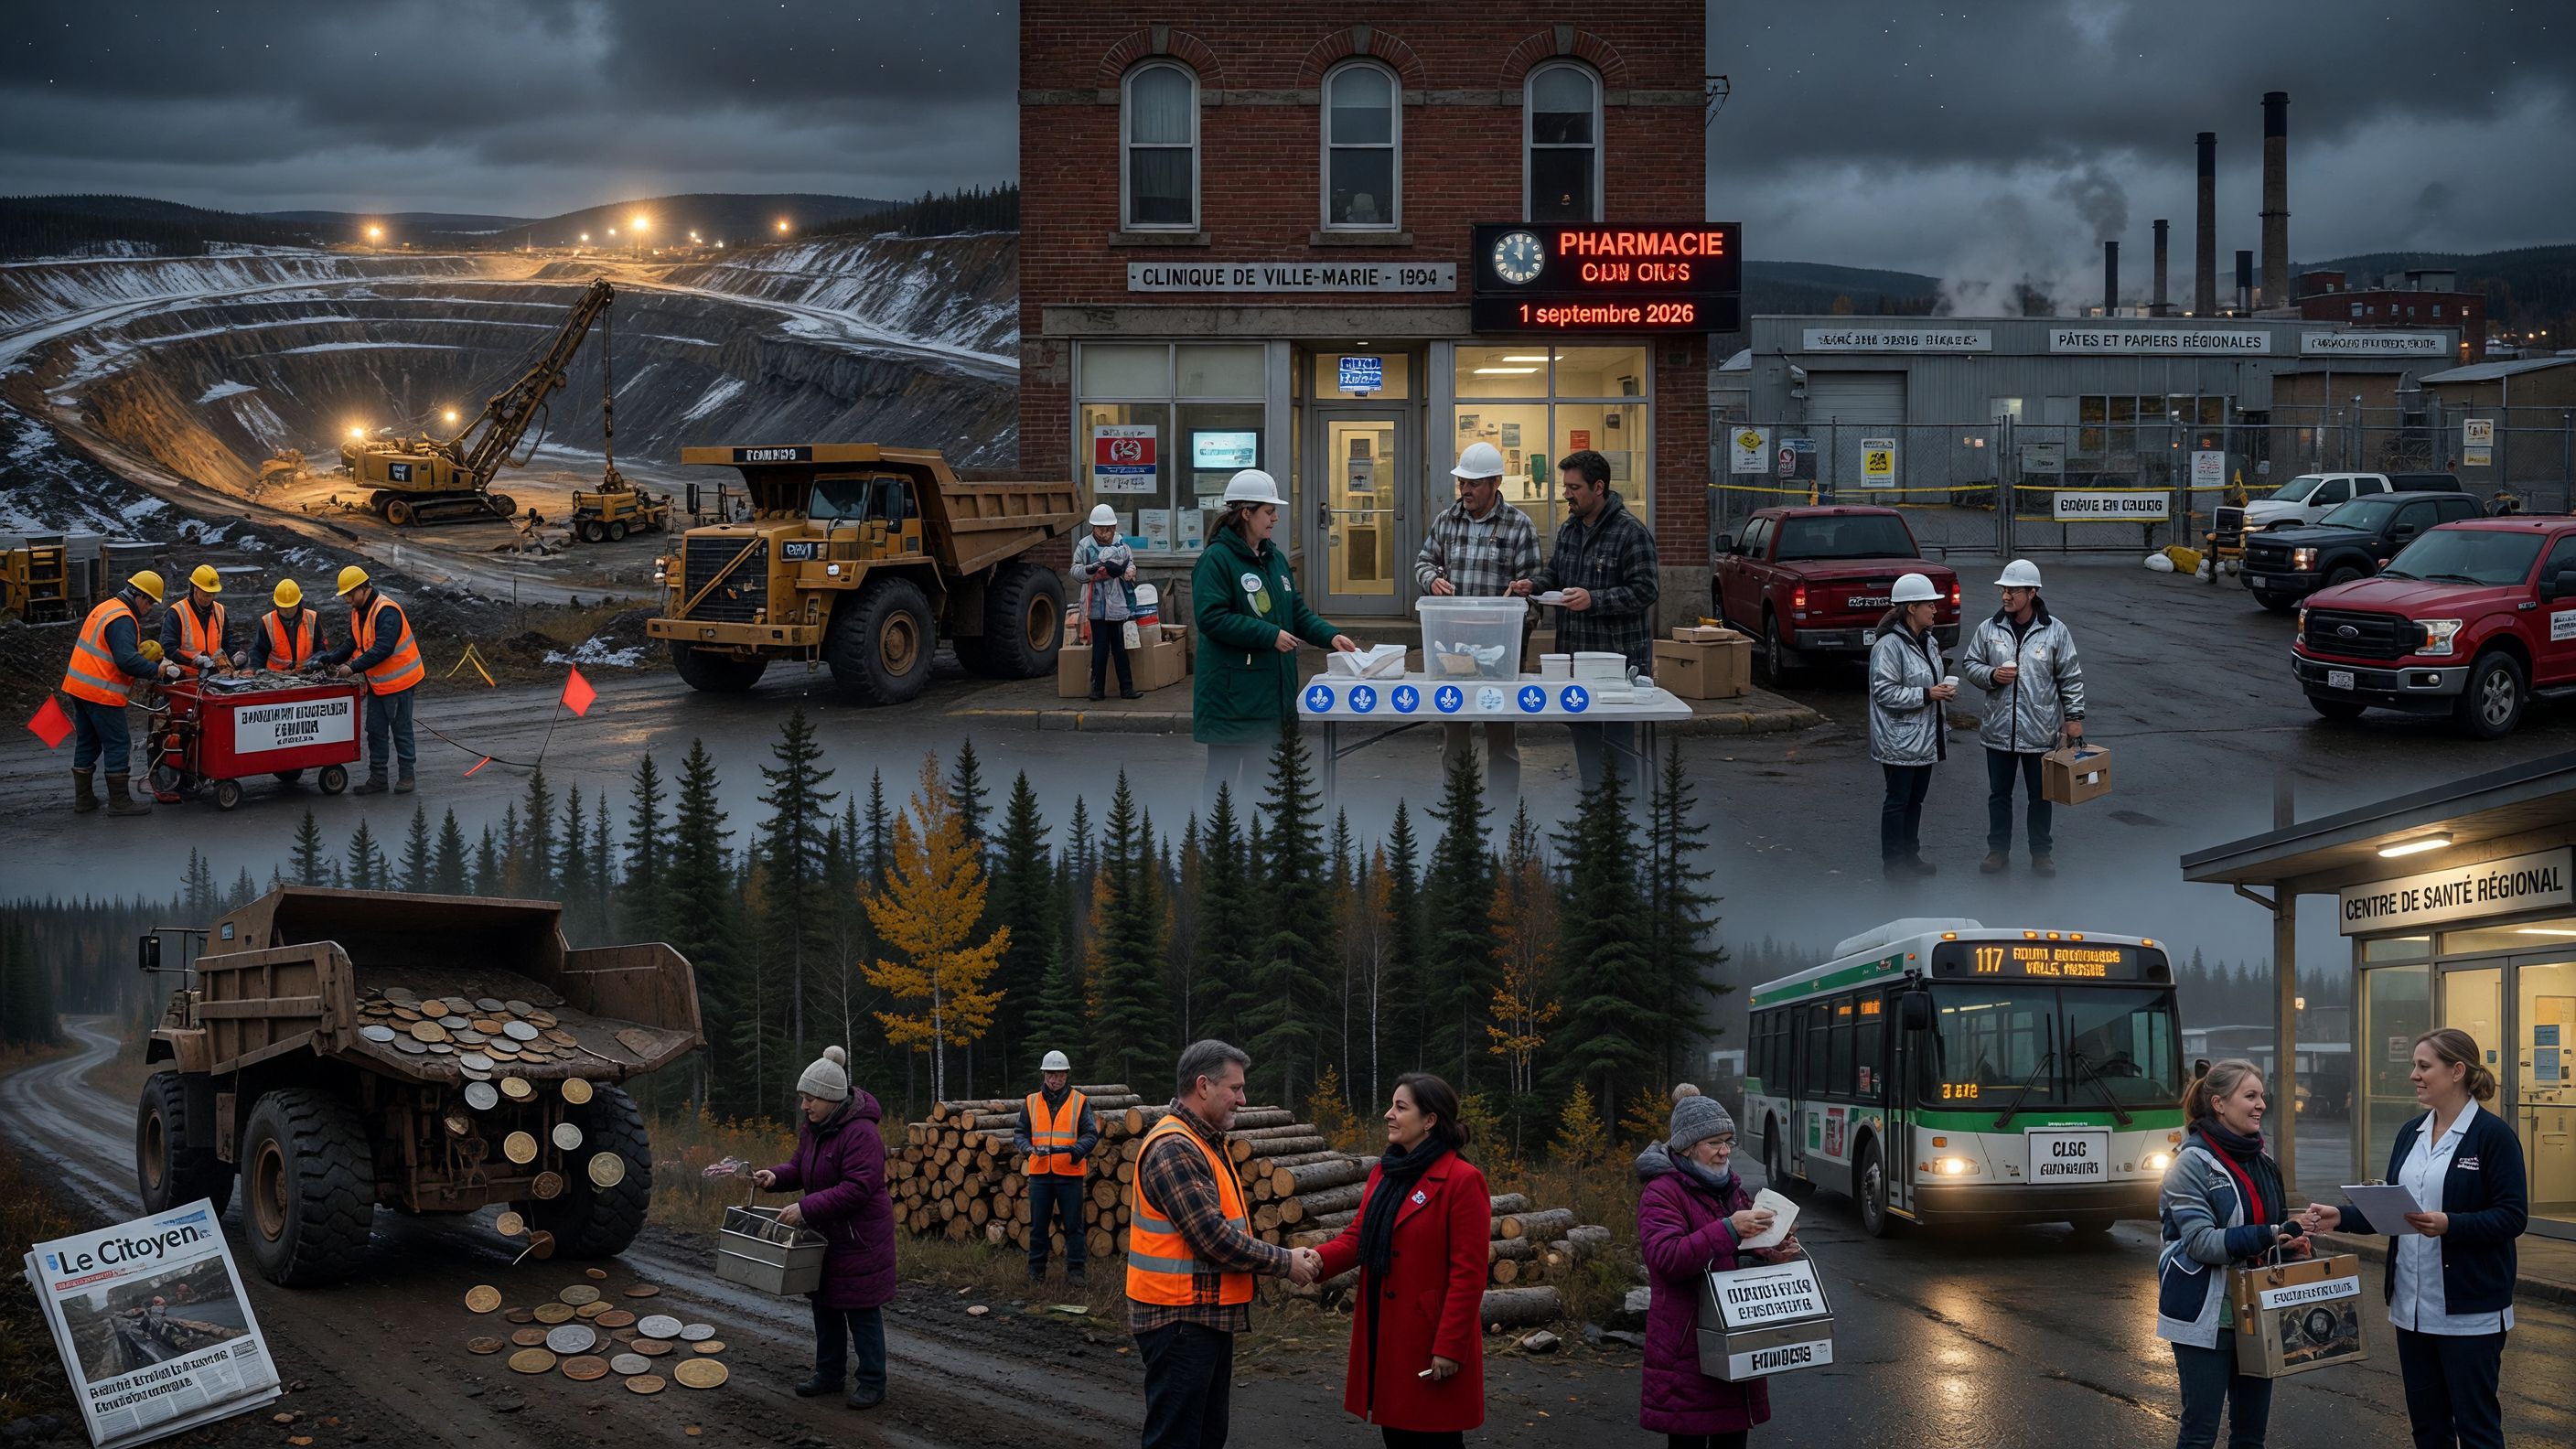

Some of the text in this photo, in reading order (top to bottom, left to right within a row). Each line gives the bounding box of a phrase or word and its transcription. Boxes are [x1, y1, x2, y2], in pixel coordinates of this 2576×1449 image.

[1560, 232, 1723, 255] PHARMACIE
[1143, 268, 1225, 287] CLINIQUE
[1235, 268, 1256, 285] DE
[1263, 268, 1379, 285] VILLE-MARIE
[1519, 304, 1694, 327] 1 septembre 2026
[2059, 331, 2261, 349] PÂTES ET PAPIERS RÉGIONALES
[2345, 866, 2564, 920] CENTRE DE SANTÉ RÉGIONAL
[1976, 947, 2003, 972] 117
[58, 1225, 199, 1275] Le Citoyen
